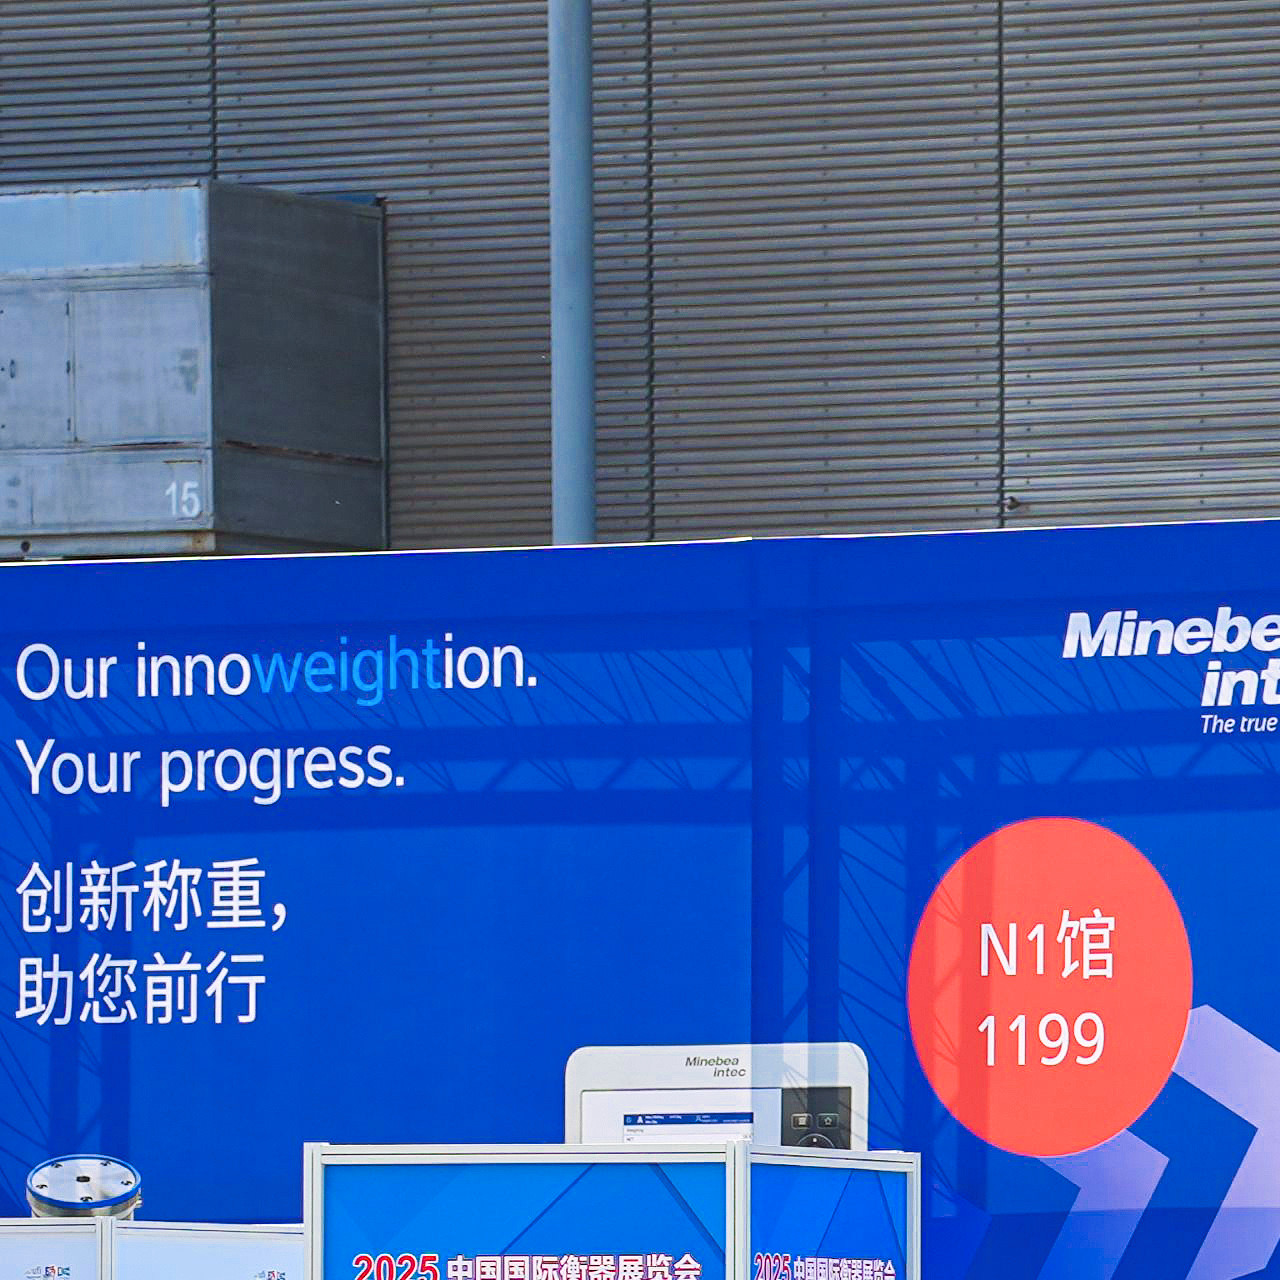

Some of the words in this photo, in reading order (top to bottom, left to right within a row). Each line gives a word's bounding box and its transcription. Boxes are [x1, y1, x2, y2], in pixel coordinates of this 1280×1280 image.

[165, 480, 200, 518] 15
[14, 642, 117, 700] Our
[136, 632, 538, 707] innoweightion.
[1201, 714, 1235, 734] The
[1239, 714, 1278, 733] true
[15, 738, 141, 795] Your
[160, 740, 406, 807] progress.
[14, 857, 288, 933] 创新称重，
[980, 908, 1116, 981] N1馆
[15, 950, 267, 1026] 助您前行
[686, 1056, 739, 1067] Minebea
[976, 1012, 1105, 1067] 1199
[713, 1067, 747, 1077] intec
